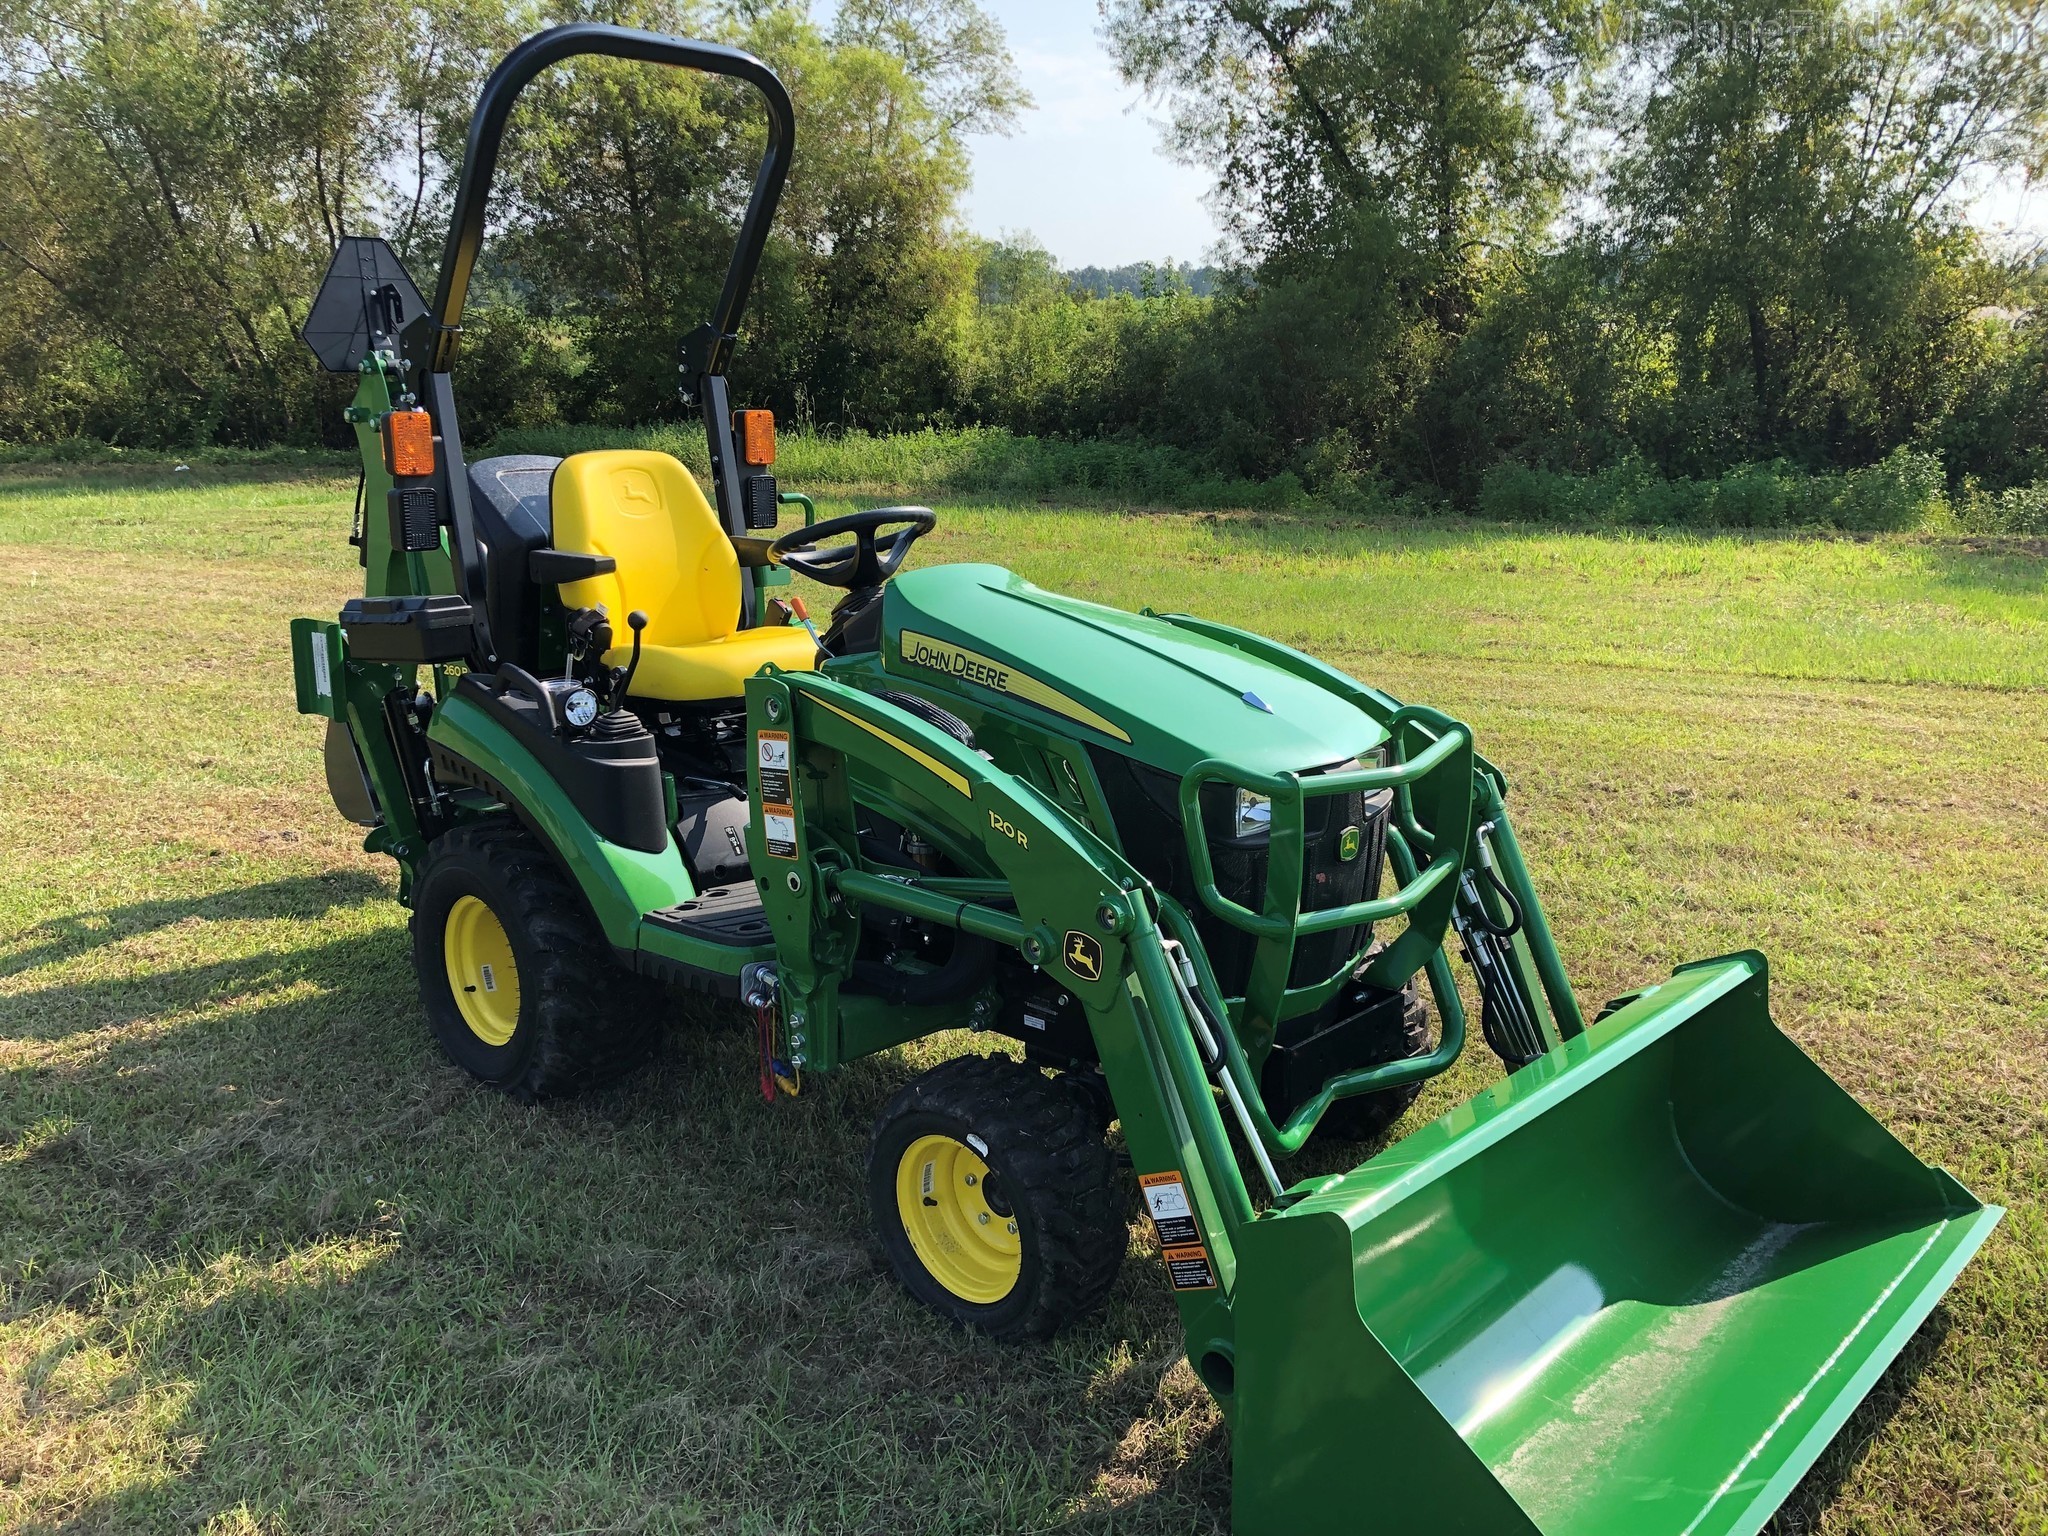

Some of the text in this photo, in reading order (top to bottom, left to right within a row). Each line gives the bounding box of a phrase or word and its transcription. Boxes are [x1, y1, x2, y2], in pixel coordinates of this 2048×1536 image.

[908, 641, 1009, 690] JOHN DEERE
[763, 732, 788, 741] WARNING
[768, 807, 793, 817] WARNING
[1149, 1175, 1177, 1184] WARNING
[1174, 1250, 1202, 1259] WARNING
